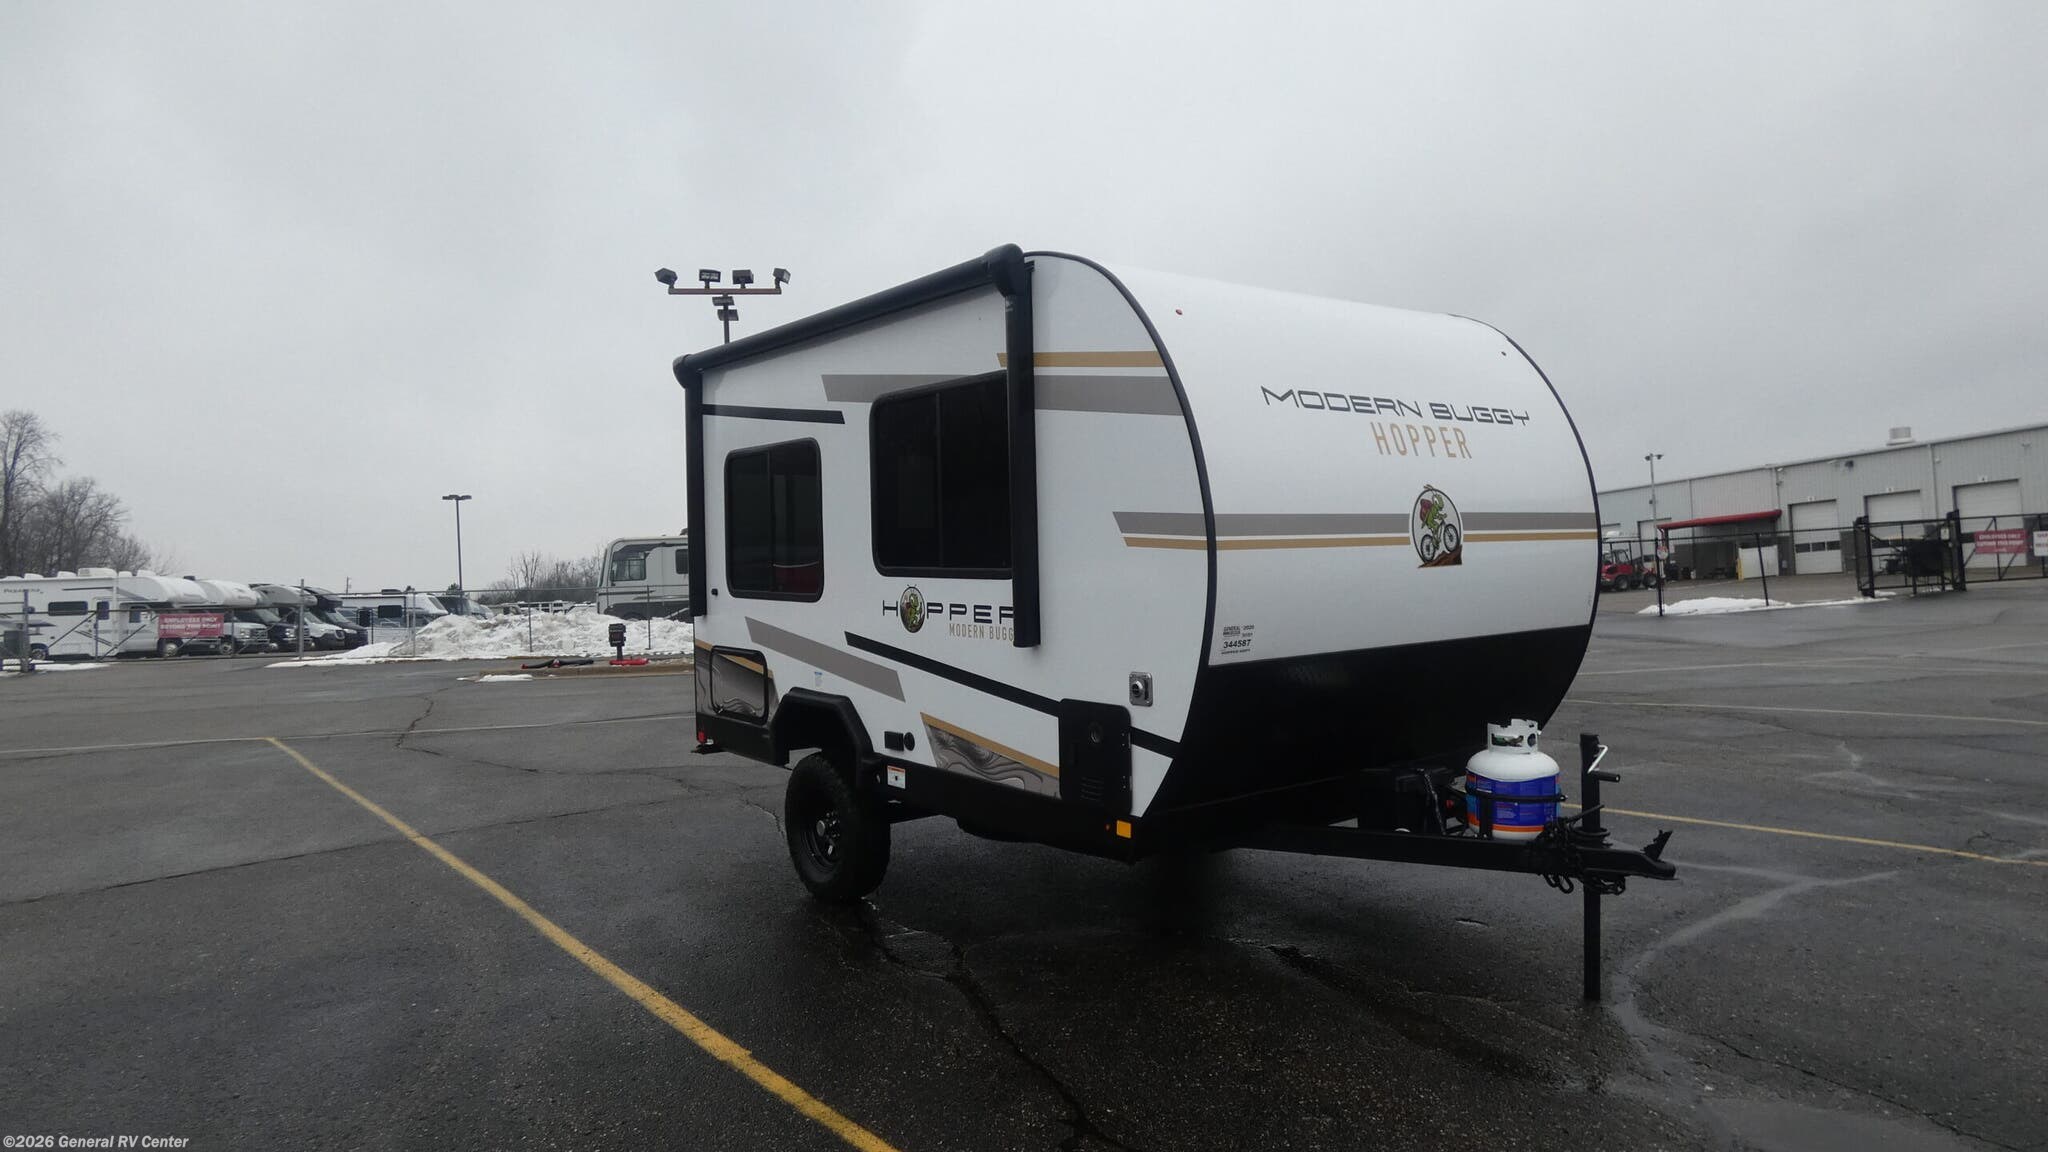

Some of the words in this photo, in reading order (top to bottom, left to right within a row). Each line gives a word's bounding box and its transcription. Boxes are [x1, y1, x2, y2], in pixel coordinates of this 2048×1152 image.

[1260, 385, 1423, 418] MODERN
[1429, 402, 1530, 426] BUGGY
[1370, 421, 1472, 459] HOPPER
[949, 623, 984, 639] MODERN
[989, 627, 1014, 641] BUGG
